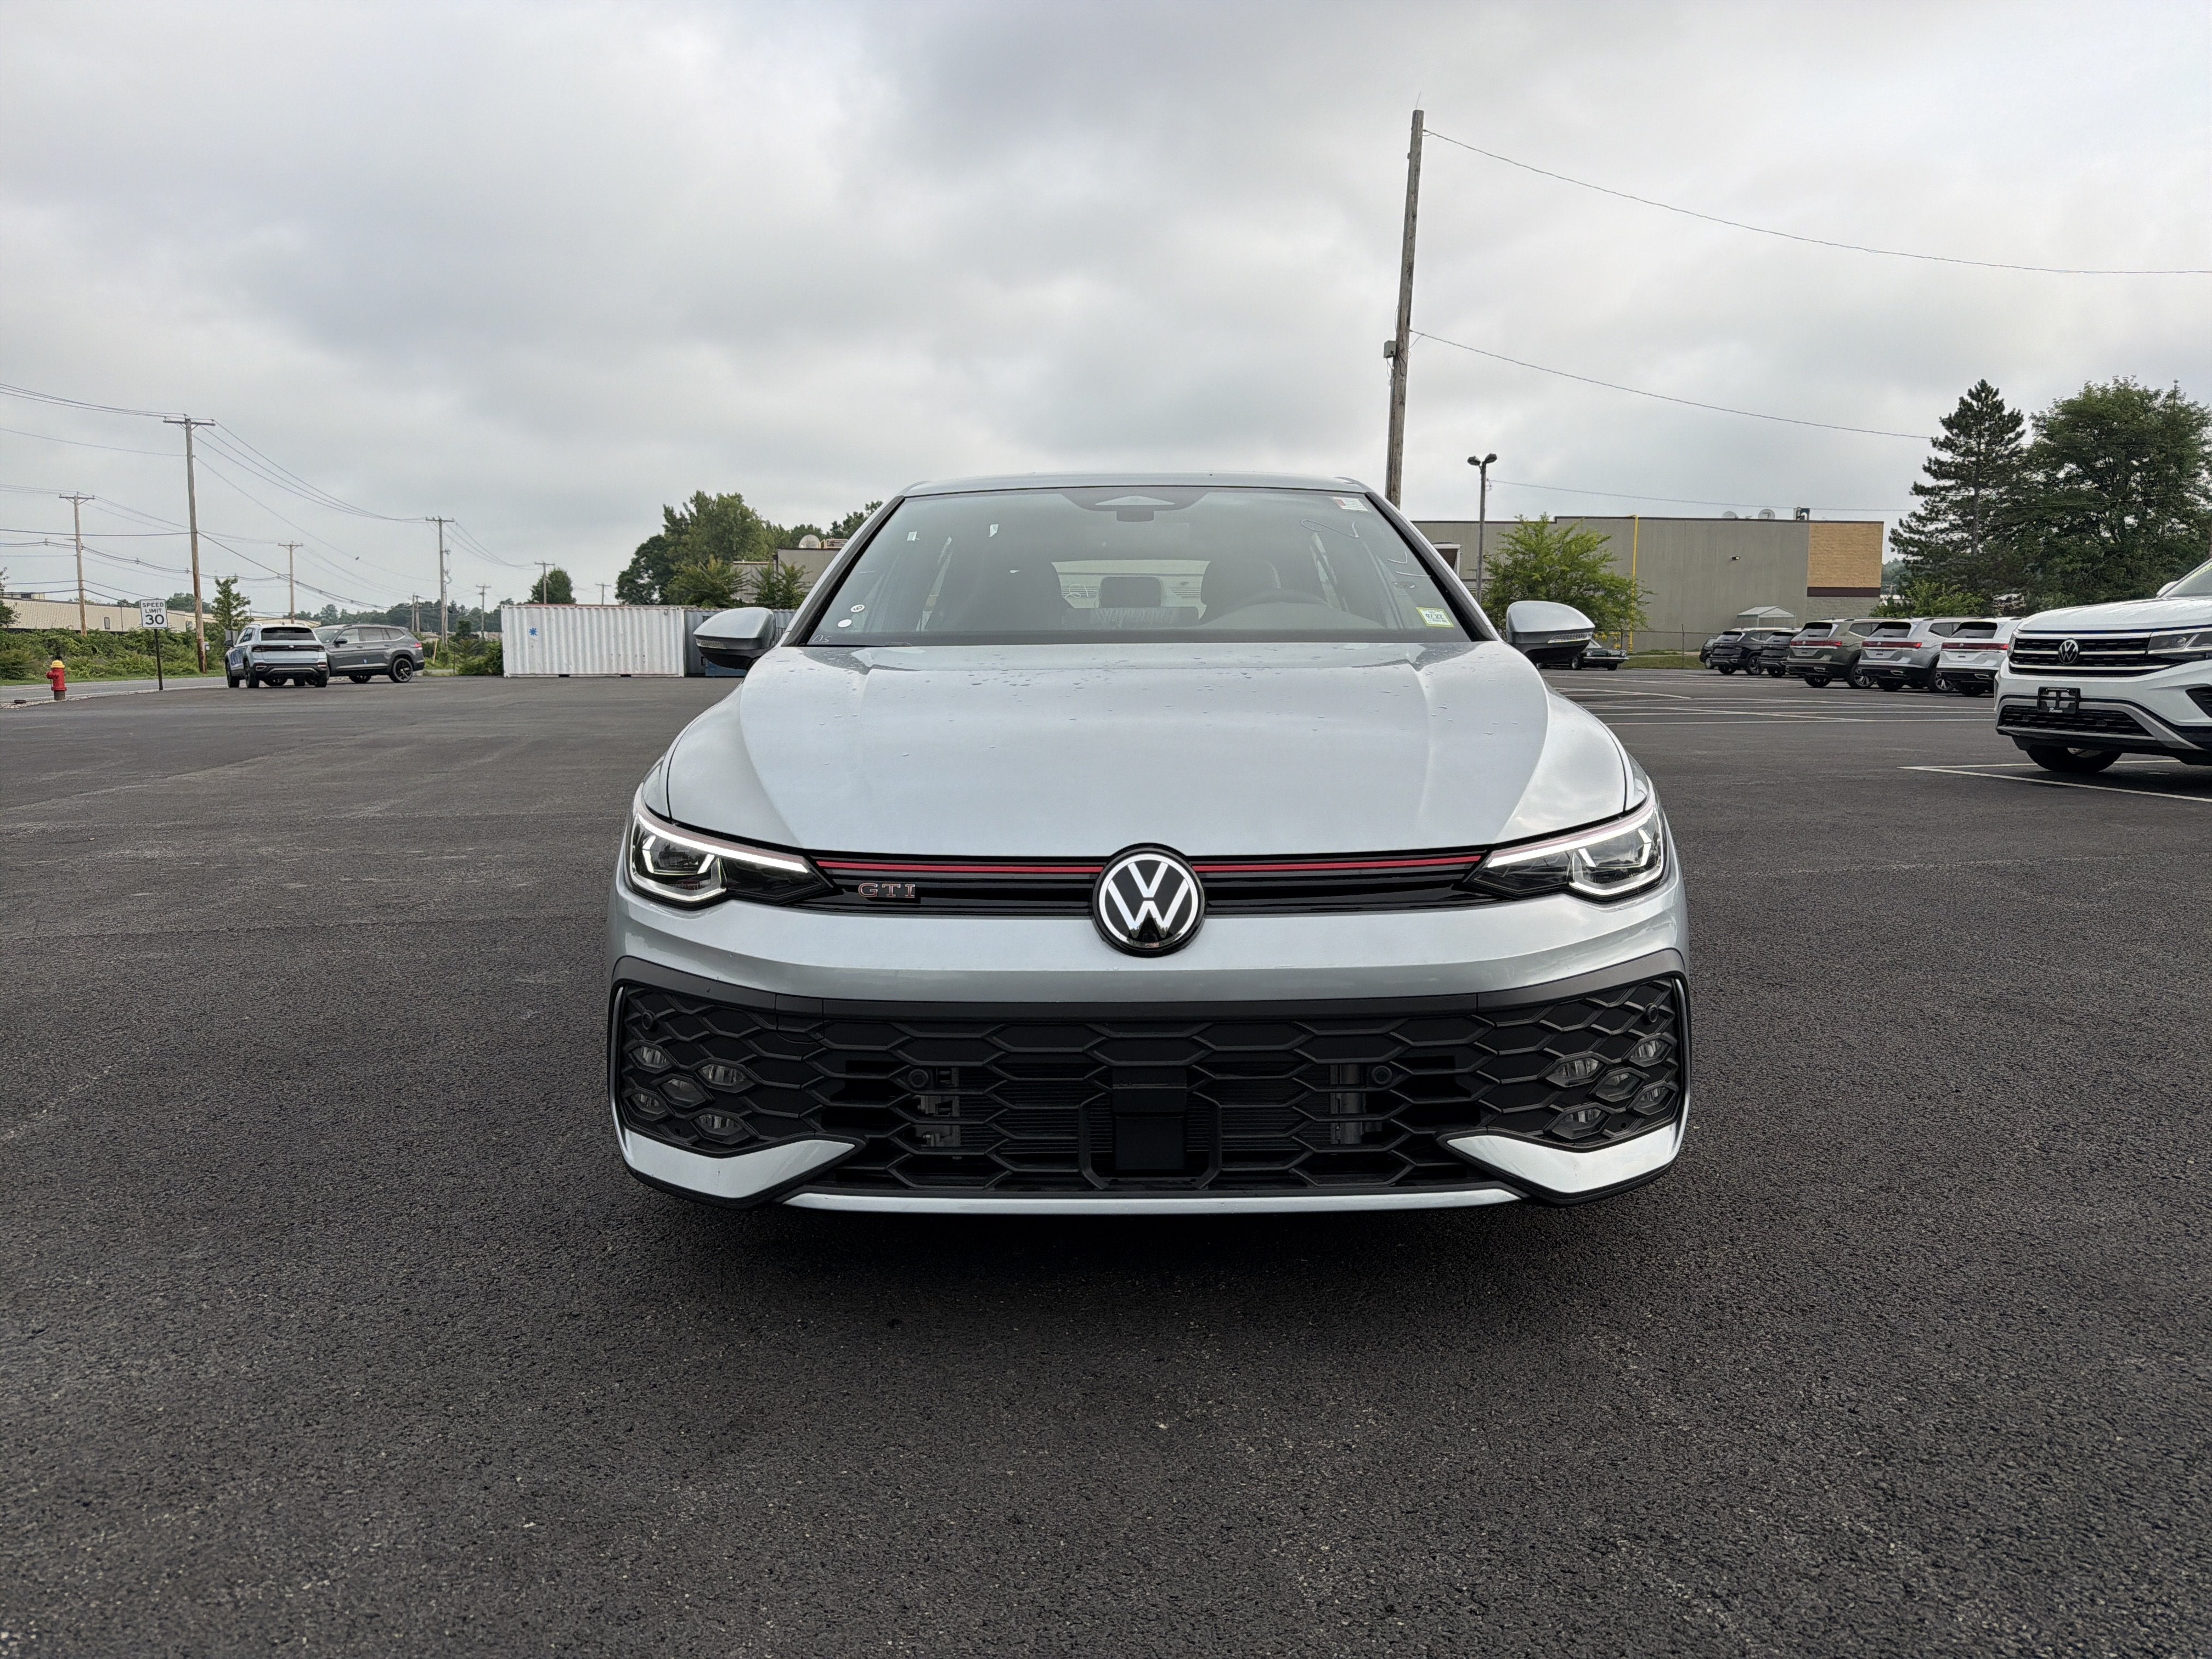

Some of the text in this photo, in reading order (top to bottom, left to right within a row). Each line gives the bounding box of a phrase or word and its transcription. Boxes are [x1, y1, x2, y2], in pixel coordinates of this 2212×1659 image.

[145, 614, 165, 625] 30
[2059, 640, 2079, 662] VW
[858, 882, 916, 899] GTI
[1103, 857, 1193, 940] VW
